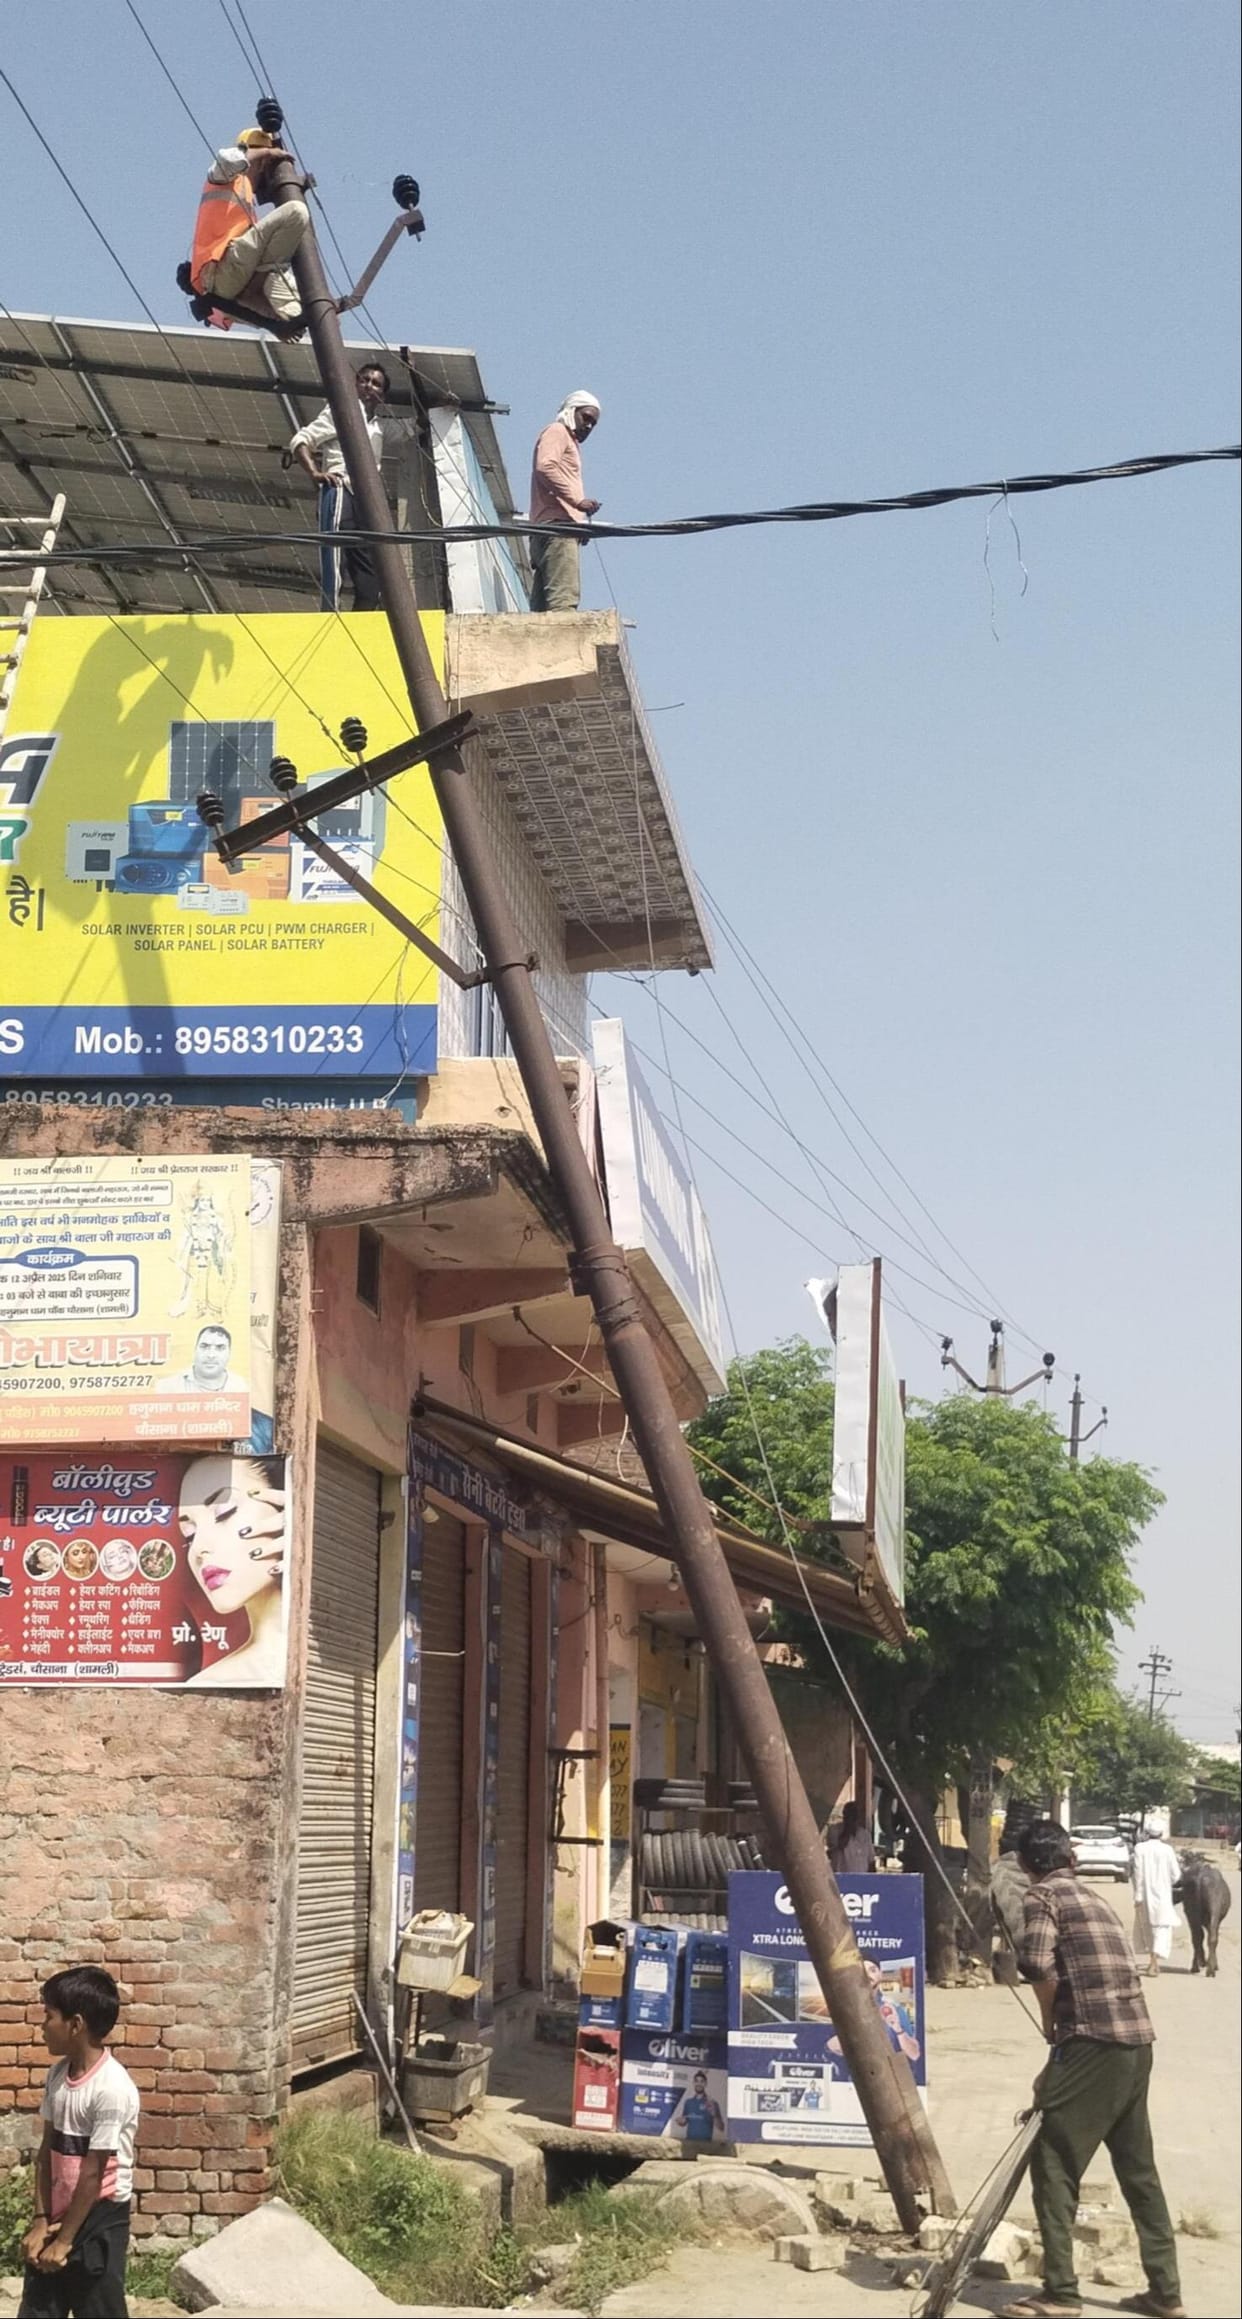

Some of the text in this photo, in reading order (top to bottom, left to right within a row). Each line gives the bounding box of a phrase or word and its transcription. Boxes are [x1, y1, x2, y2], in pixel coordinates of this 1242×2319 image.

[82, 925, 123, 935] SOLAR
[126, 923, 185, 935] INVERTER
[196, 924, 236, 935] SOLAR
[240, 924, 264, 935] PCU
[275, 923, 306, 935] PWM
[310, 922, 368, 935] CHARGER
[134, 940, 174, 952] SOLAR
[178, 939, 217, 951] PANEL
[227, 939, 268, 951] SOLAR
[271, 938, 325, 951] BATTERY
[175, 1025, 364, 1053] 8958310233
[40, 1166, 51, 1175] श्री
[21, 1217, 37, 1228] इस
[40, 1214, 55, 1226] वर्ष
[57, 1213, 70, 1225] भी
[23, 1232, 33, 1244] के
[36, 1235, 56, 1243] साथ
[59, 1231, 72, 1243] श्री
[100, 1230, 113, 1242] जी
[116, 1232, 154, 1242] महाराज
[157, 1229, 171, 1240] की
[26, 1250, 75, 1266] कार्यक्रम
[11, 1275, 19, 1283] 12
[48, 1273, 66, 1282] 2025
[68, 1270, 86, 1281] दिन
[88, 1269, 122, 1280] शनिवार
[18, 1288, 35, 1300] बजे
[37, 1288, 46, 1300] से
[70, 1287, 82, 1298] की
[70, 1376, 152, 1389] 9758752727
[52, 1464, 156, 1497] बॉलीवुड
[34, 1498, 172, 1531] ब्यूटी पार्लर
[172, 1621, 229, 1650] प्रो. रेणू
[74, 1663, 119, 1676] (शामली)
[752, 1933, 780, 1945] XTRA
[857, 1937, 902, 1949] BATTERY
[648, 2037, 709, 2061] Oliver
